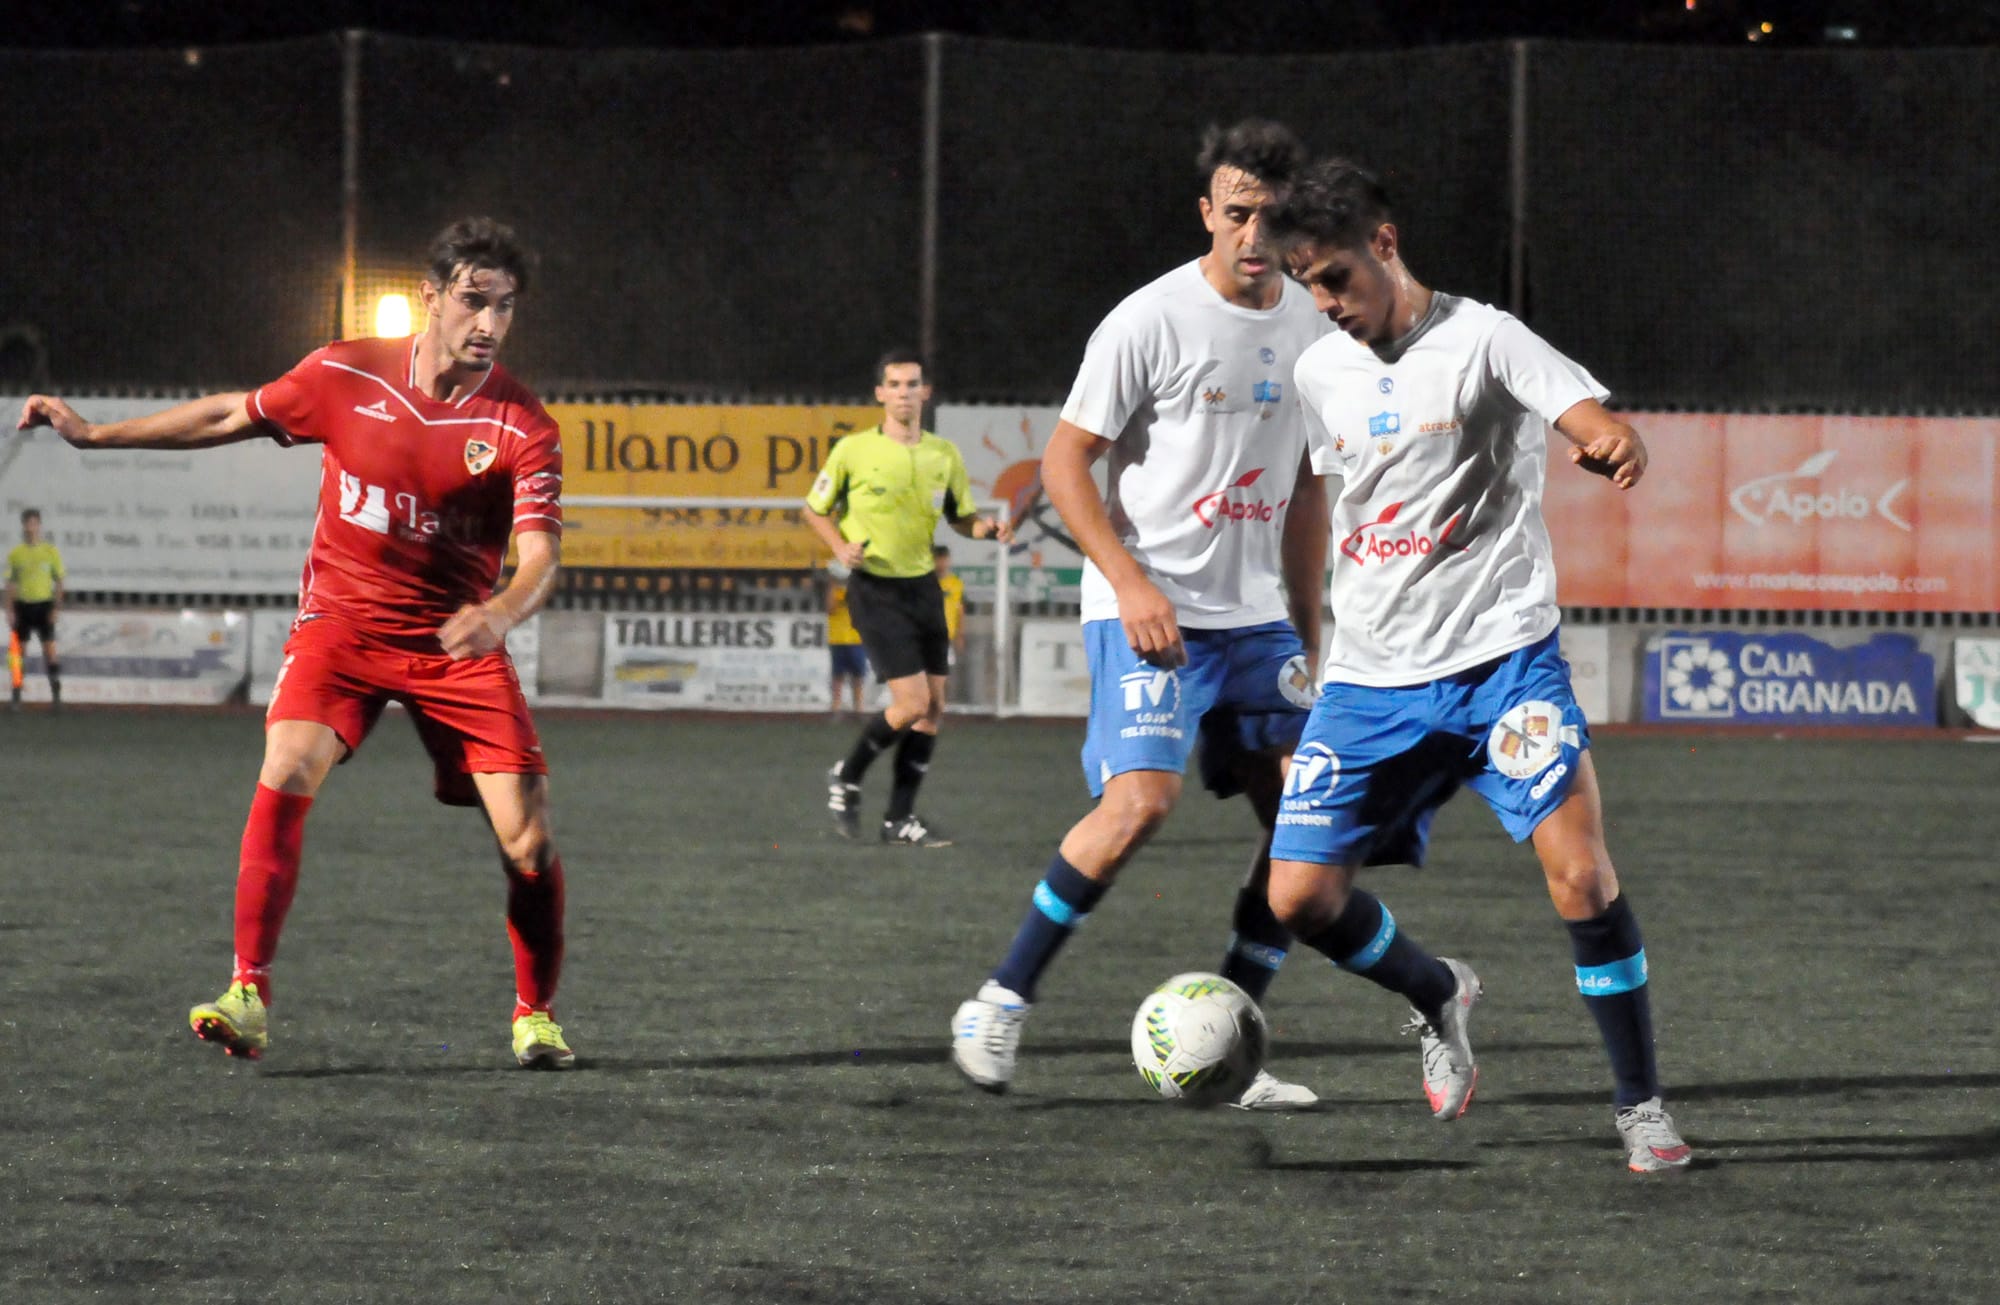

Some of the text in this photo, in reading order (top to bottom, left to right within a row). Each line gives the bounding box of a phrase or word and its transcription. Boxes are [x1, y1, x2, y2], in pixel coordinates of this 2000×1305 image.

[583, 419, 740, 473] llano
[1217, 491, 1273, 527] Apolo
[1766, 488, 1869, 522] Apolo
[1366, 530, 1433, 565] Apolo
[1693, 571, 1946, 594] www.mariscosapolo.com
[615, 618, 775, 648] TALLERES
[1120, 665, 1170, 710] TV
[1738, 680, 1918, 715] GRANADA
